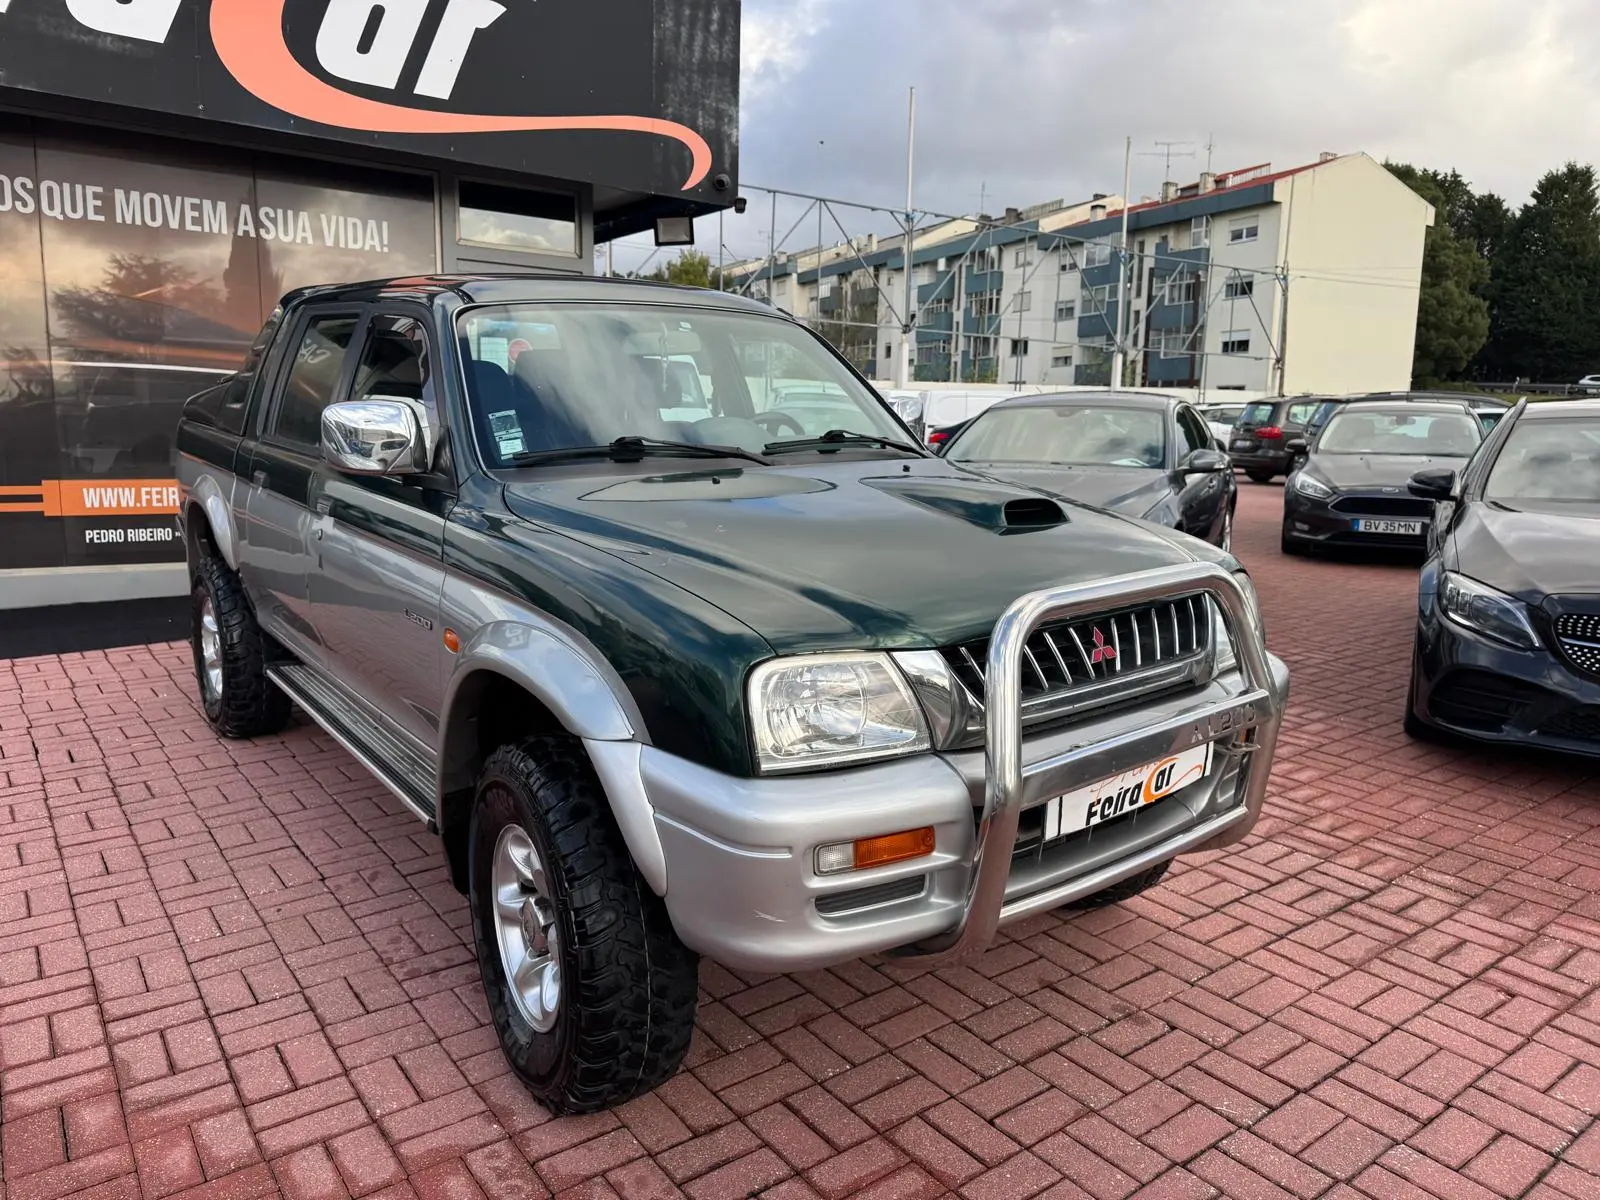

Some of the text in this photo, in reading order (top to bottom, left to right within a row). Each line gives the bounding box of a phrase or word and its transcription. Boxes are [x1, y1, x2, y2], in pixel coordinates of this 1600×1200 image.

[113, 188, 229, 236] MOVEM
[319, 213, 390, 253] VIDA!
[82, 486, 181, 509] WWW.FEIR
[85, 527, 173, 544] PEDRO RIBEIRO
[403, 607, 433, 631] L200
